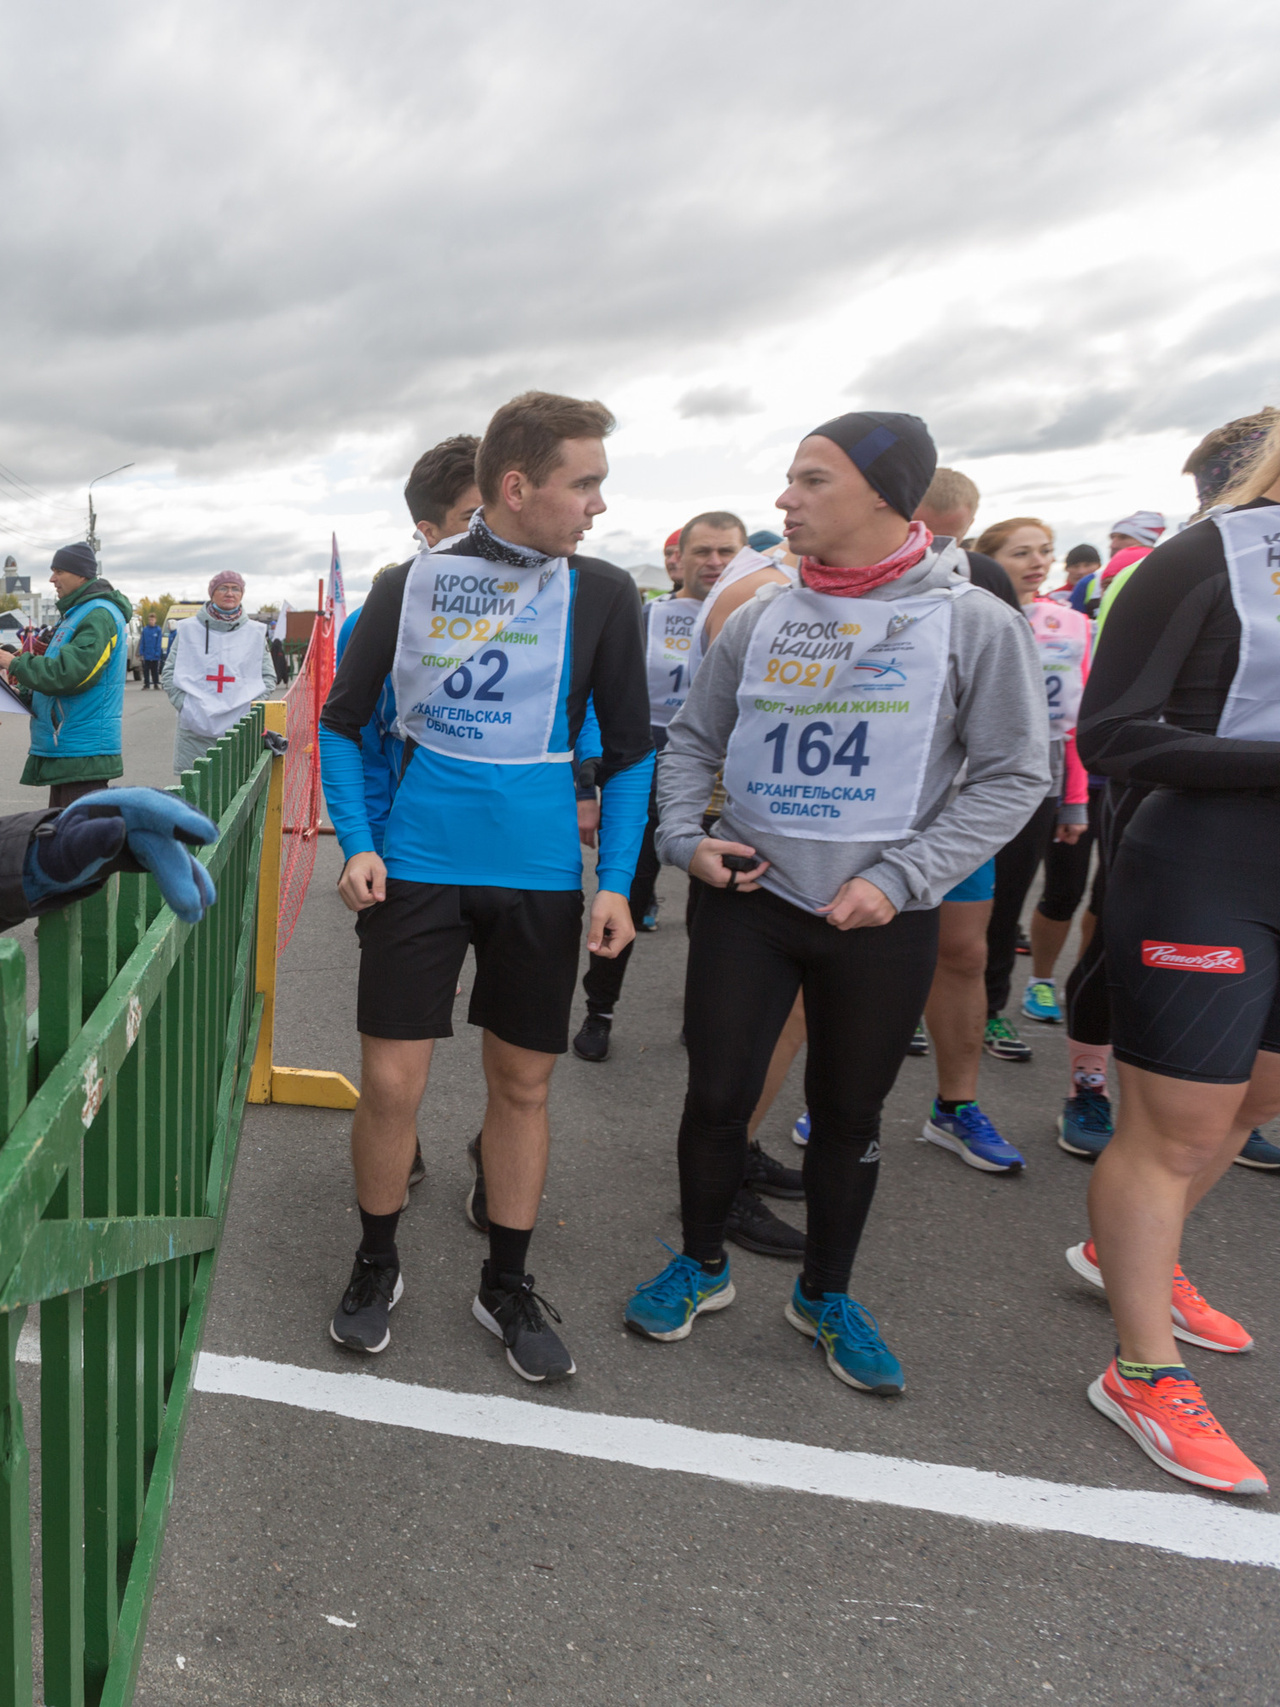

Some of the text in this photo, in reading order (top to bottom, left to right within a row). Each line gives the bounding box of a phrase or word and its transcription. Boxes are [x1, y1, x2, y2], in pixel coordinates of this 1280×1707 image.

[433, 573, 499, 596] КРОСС
[431, 593, 515, 617] НАЦИИ
[427, 615, 505, 642] 2021
[778, 620, 839, 640] КРОСС
[769, 636, 855, 661] НАЦИИ
[421, 654, 463, 669] СПОРТ
[669, 664, 684, 693] 1
[762, 658, 837, 689] 2021
[794, 701, 849, 716] НОРМА
[849, 700, 911, 714] ЖИЗНИ
[426, 718, 484, 740] ОБЛАСТЬ
[763, 720, 871, 778] 164
[746, 781, 877, 802] АРХАНГЕЛЬСКАЯ
[769, 801, 841, 819] ОБЛАСТЬ
